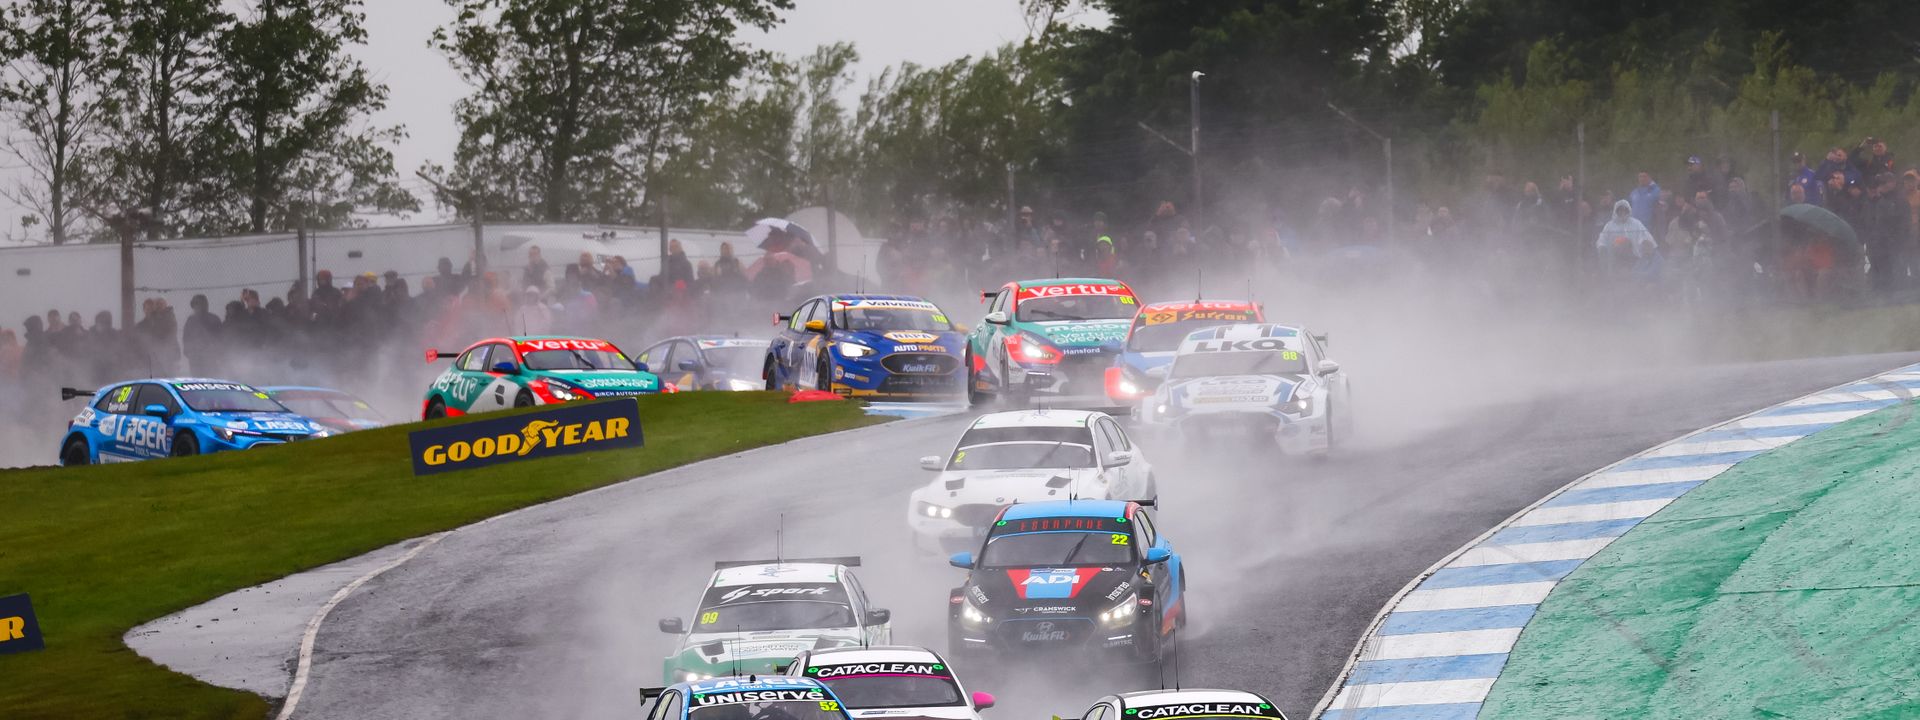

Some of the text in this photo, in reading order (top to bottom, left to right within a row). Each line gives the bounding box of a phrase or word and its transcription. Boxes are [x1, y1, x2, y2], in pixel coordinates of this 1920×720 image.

[1029, 284, 1107, 298] vertu
[1063, 347, 1100, 355] Hansford
[1194, 339, 1288, 353] LKQ
[1282, 351, 1298, 360] 88
[254, 421, 308, 431] LASER
[117, 415, 171, 453] LASER
[955, 452, 965, 463] 2
[1111, 534, 1128, 545] 22
[1020, 575, 1080, 585] ADI
[700, 611, 718, 624] 99
[817, 663, 934, 677] CATACLEAN
[820, 702, 839, 711] 52
[1137, 703, 1260, 719] CATACLEAN
